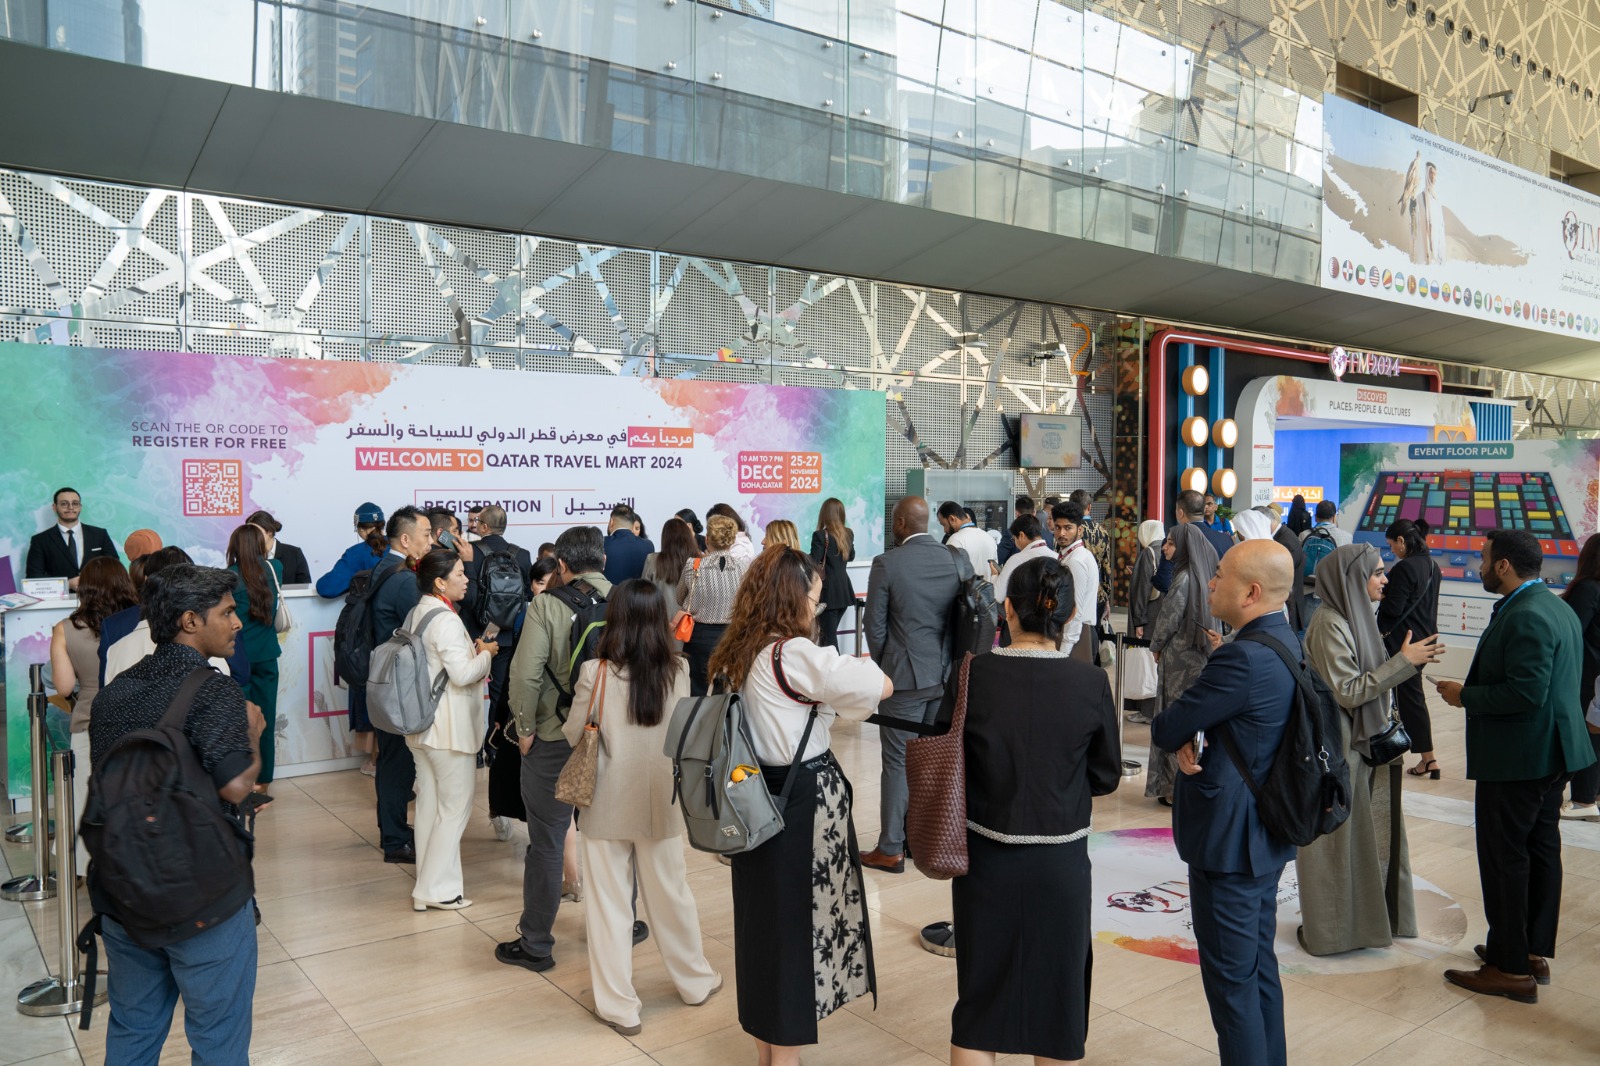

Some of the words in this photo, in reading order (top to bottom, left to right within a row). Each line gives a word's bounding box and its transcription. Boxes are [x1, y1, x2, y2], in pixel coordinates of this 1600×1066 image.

[1410, 133, 1424, 142] UNDER
[1432, 141, 1454, 154] PATRONAGE
[1357, 391, 1387, 402] DISCOVER
[1354, 404, 1376, 414] PEOPLE
[1378, 406, 1382, 414] &
[1384, 406, 1411, 417] CULTURES
[132, 422, 170, 432] SCAN
[175, 422, 200, 433] THE
[206, 424, 224, 434] QR
[229, 424, 266, 434] CODE
[270, 425, 288, 435] TO
[346, 423, 403, 440] والسفر
[408, 424, 472, 441] للسياحة
[528, 427, 556, 443] قطر
[132, 435, 209, 448] REGISTER
[215, 437, 245, 448] FOR
[251, 438, 287, 449] FREE
[476, 427, 525, 446] الدولي
[560, 430, 603, 444] معرض
[607, 428, 626, 448] في
[630, 432, 656, 446] بكم
[1414, 448, 1444, 456] EVENT
[1447, 447, 1478, 456] FLOOR
[1481, 447, 1508, 455] PLAN
[359, 451, 452, 467] WELCOME
[457, 453, 481, 467] TO
[486, 454, 539, 468] QATAR
[544, 455, 601, 468] TRAVEL
[606, 456, 646, 468] MART
[650, 456, 682, 469] 2024
[790, 456, 819, 466] 25-27
[741, 464, 783, 480] DECC
[790, 476, 819, 489] 2024
